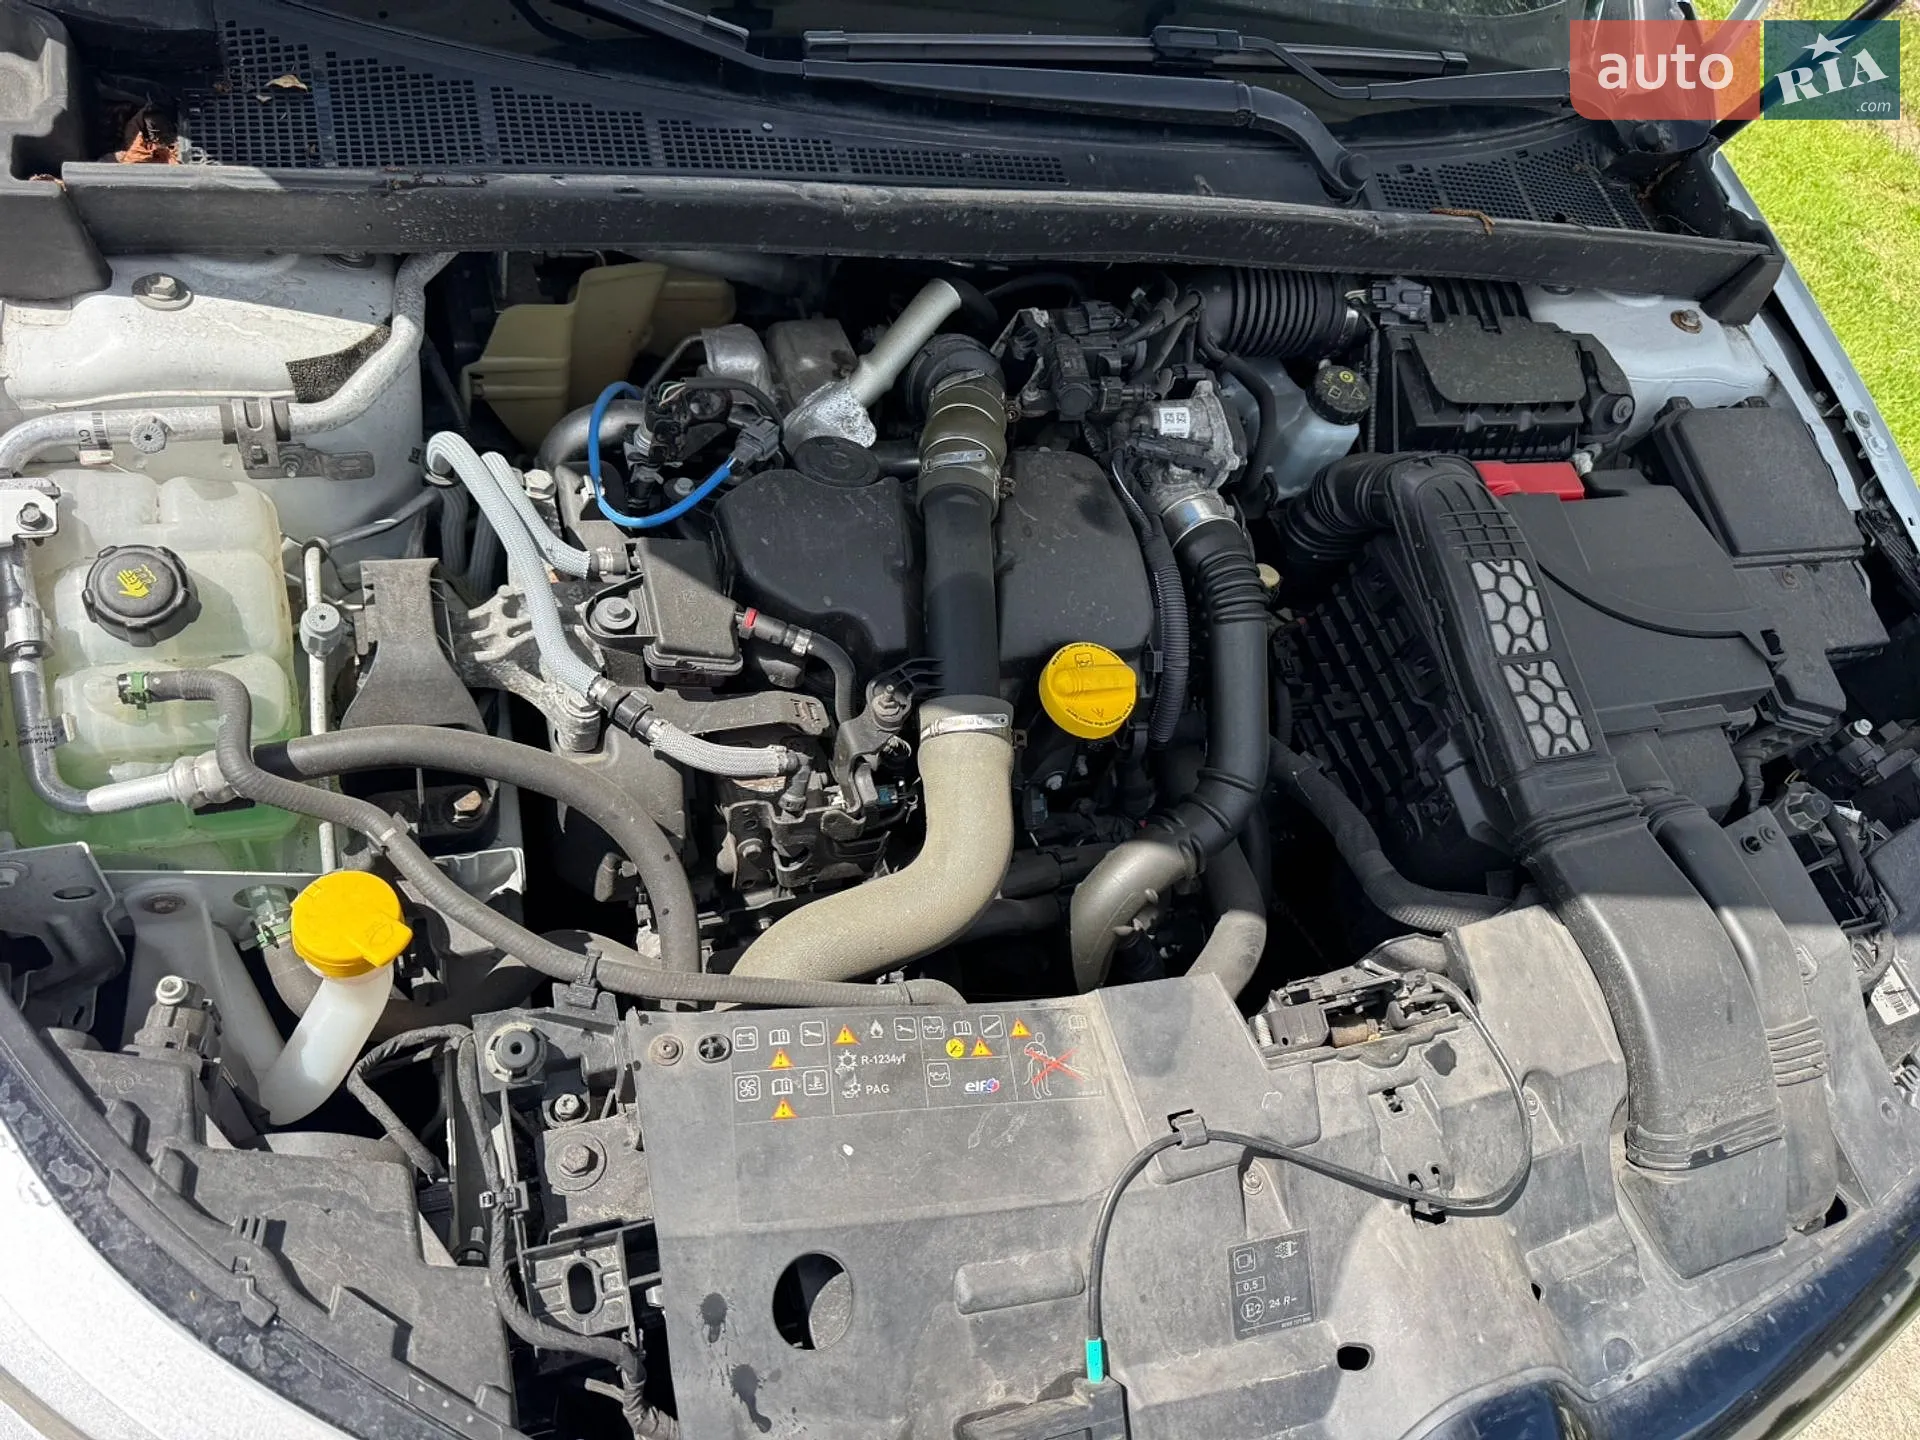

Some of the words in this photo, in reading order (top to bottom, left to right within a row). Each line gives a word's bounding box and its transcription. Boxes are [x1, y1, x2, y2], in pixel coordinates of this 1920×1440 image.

[861, 1053, 907, 1065] R-1234yf
[865, 1083, 890, 1095] PAG
[964, 1080, 988, 1092] elf
